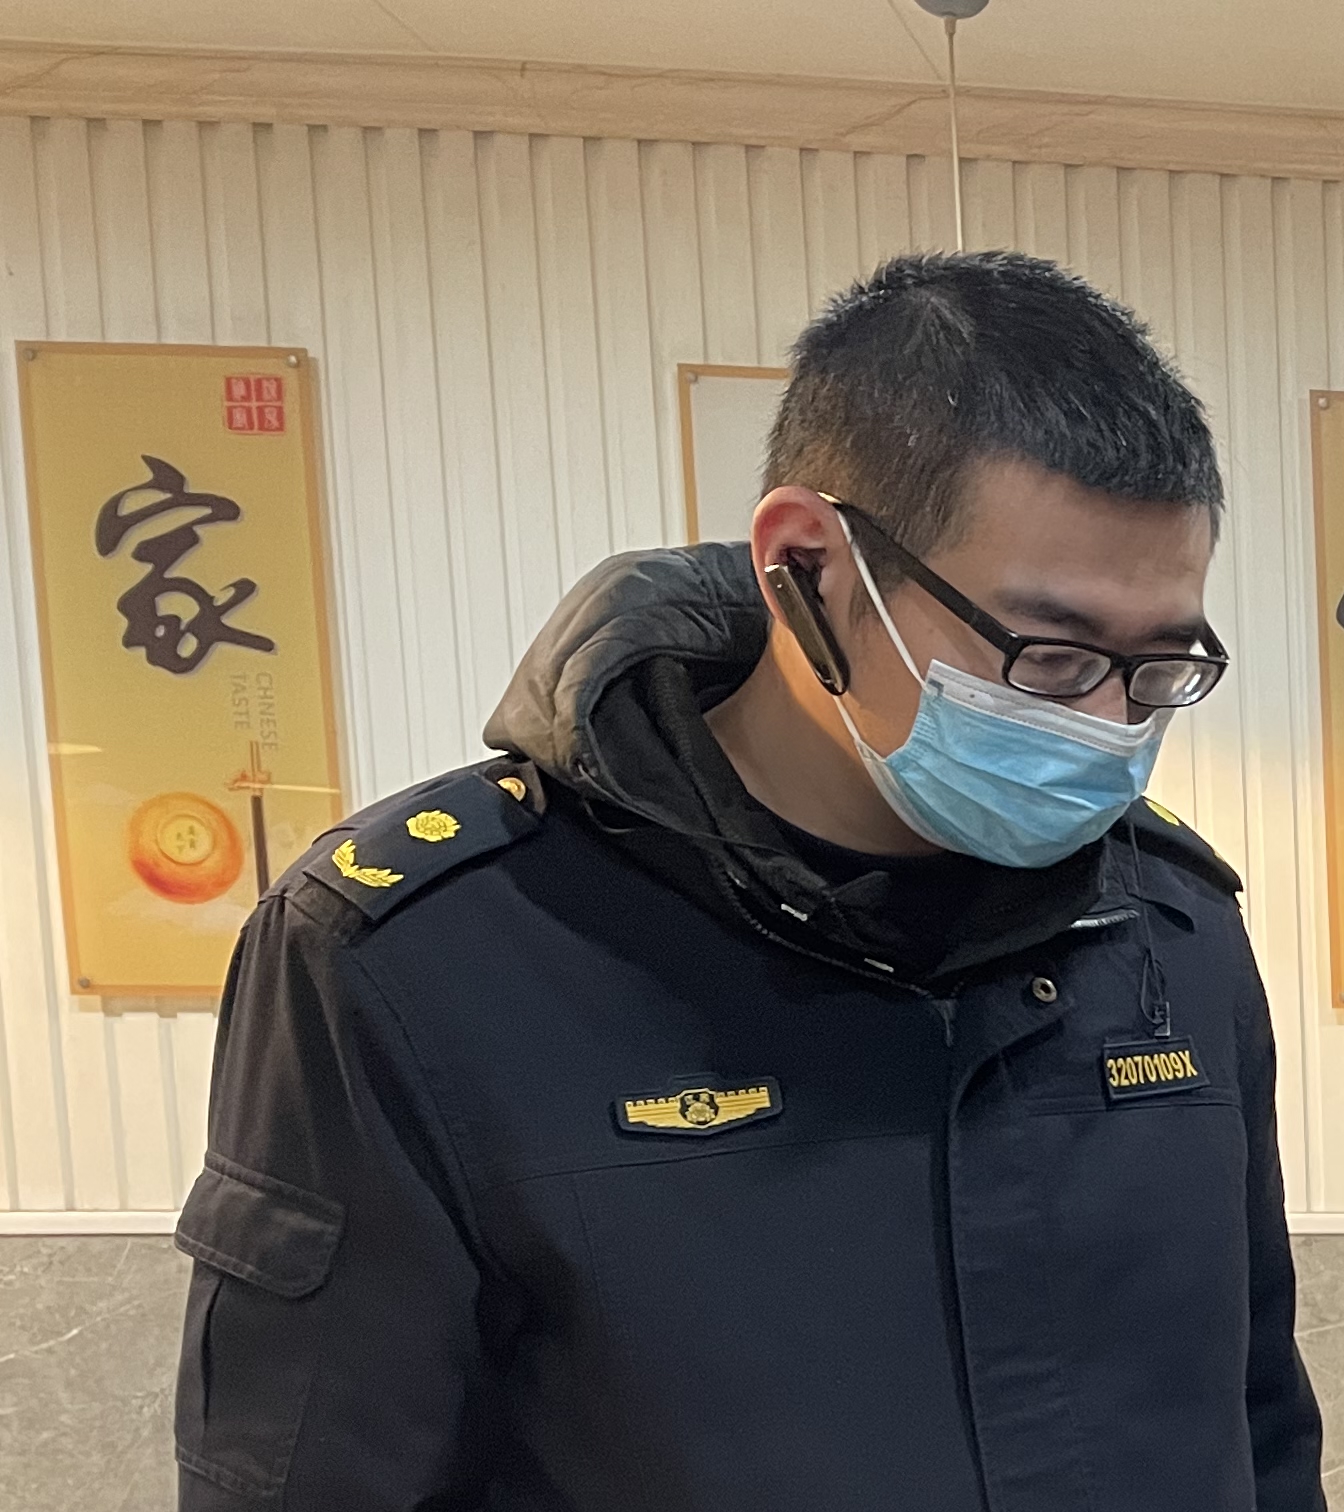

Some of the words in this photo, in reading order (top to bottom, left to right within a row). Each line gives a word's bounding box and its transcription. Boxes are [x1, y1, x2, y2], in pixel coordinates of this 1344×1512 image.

[95, 454, 276, 675] 家
[231, 671, 250, 730] TASTE
[1107, 1050, 1198, 1087] 32070109X
